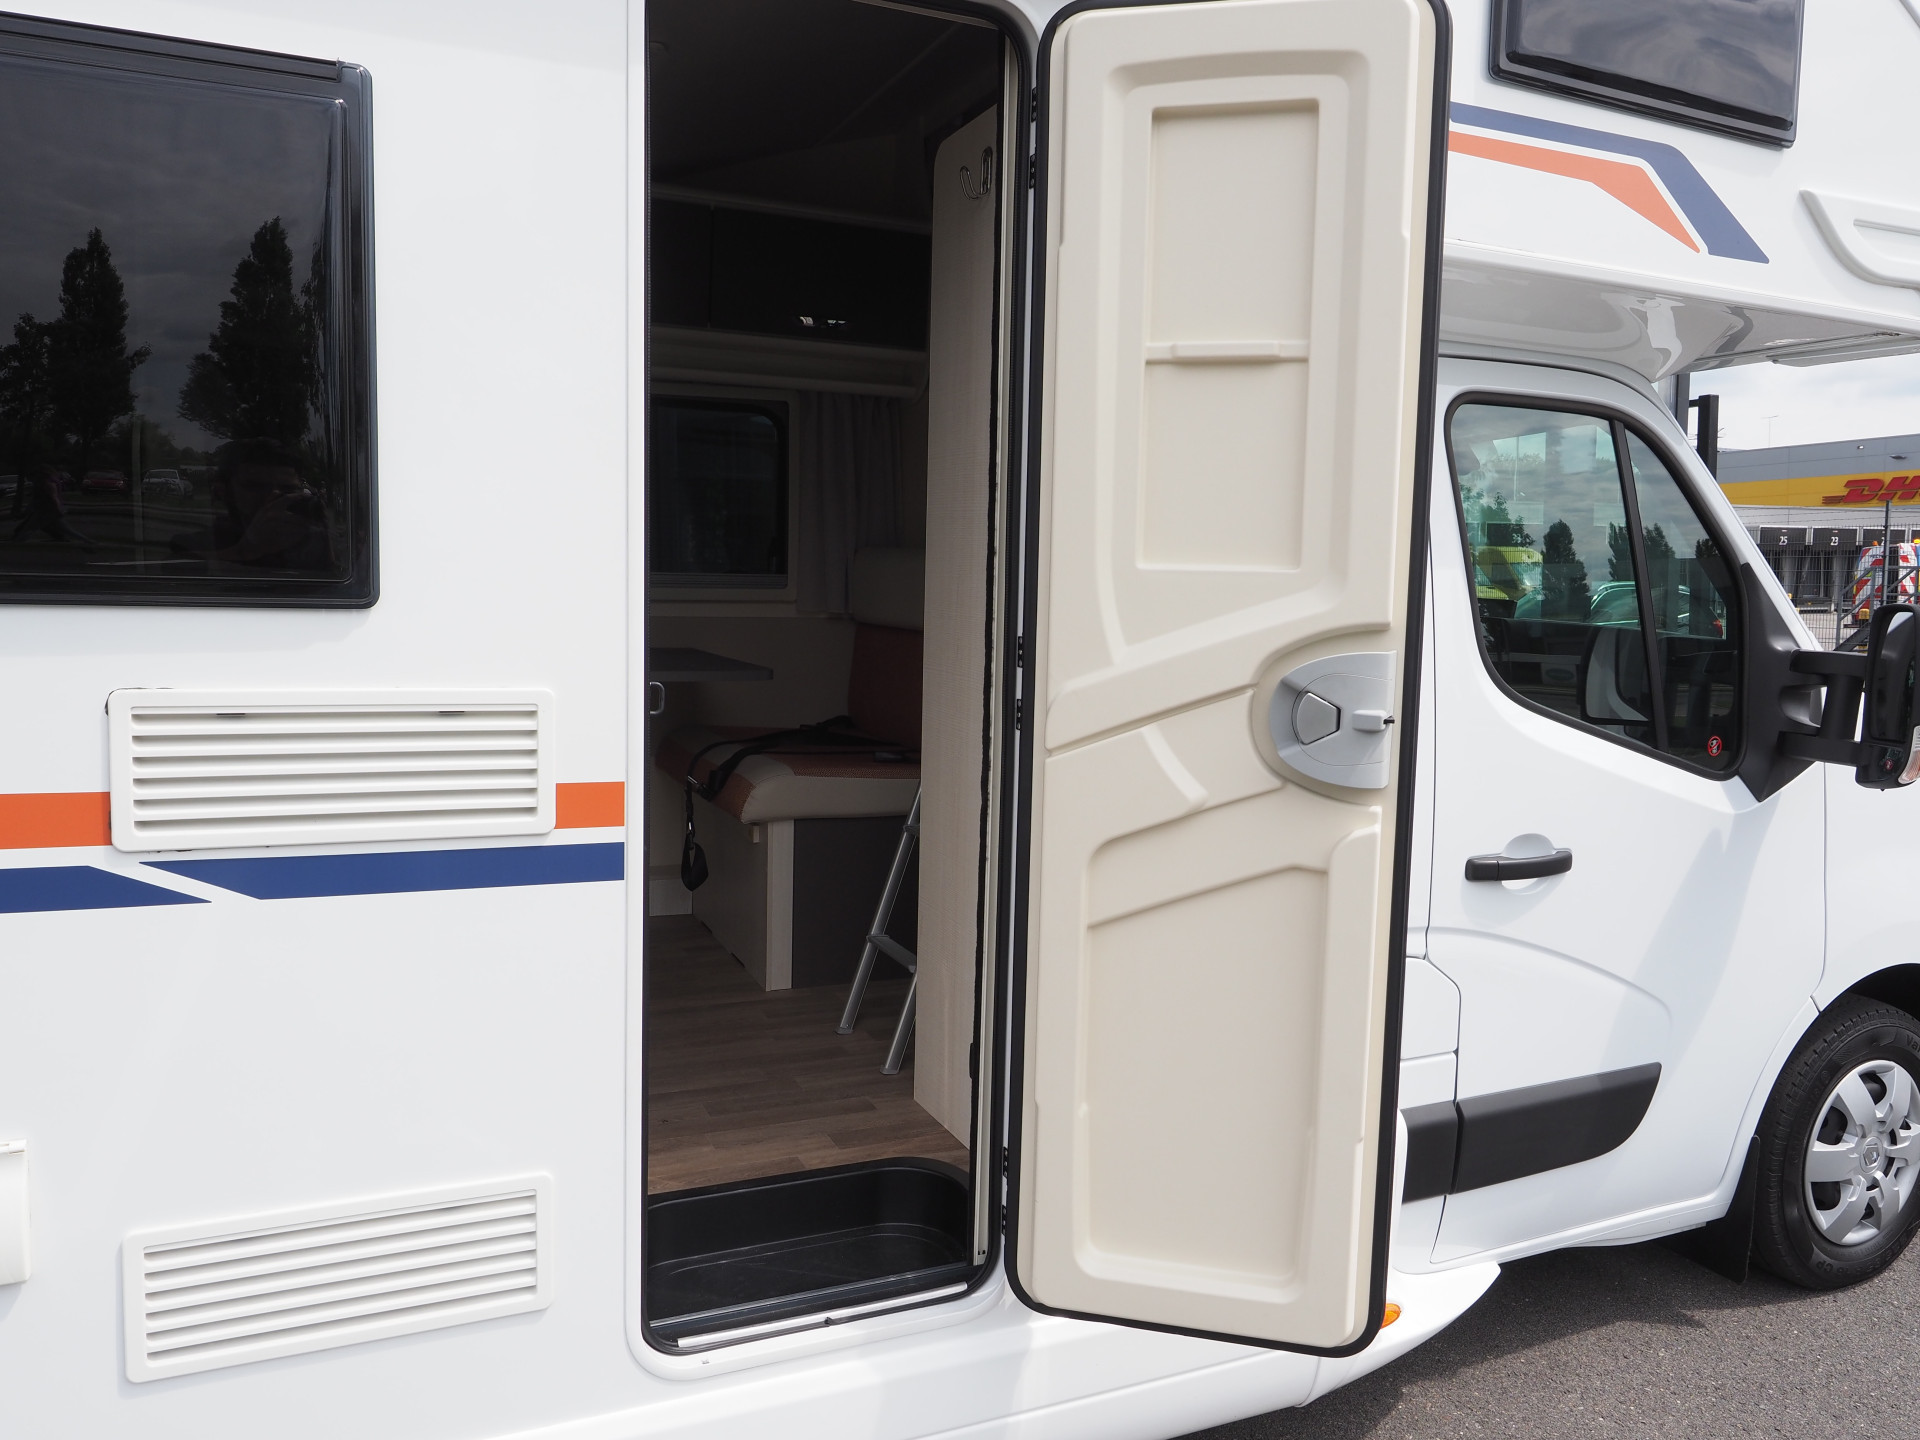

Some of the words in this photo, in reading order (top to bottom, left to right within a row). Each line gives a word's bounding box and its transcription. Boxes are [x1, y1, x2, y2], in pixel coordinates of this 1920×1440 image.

[1842, 475, 1920, 503] DH
[1779, 536, 1788, 546] 25
[1830, 536, 1839, 546] 23
[1906, 1033, 1920, 1053] Va
